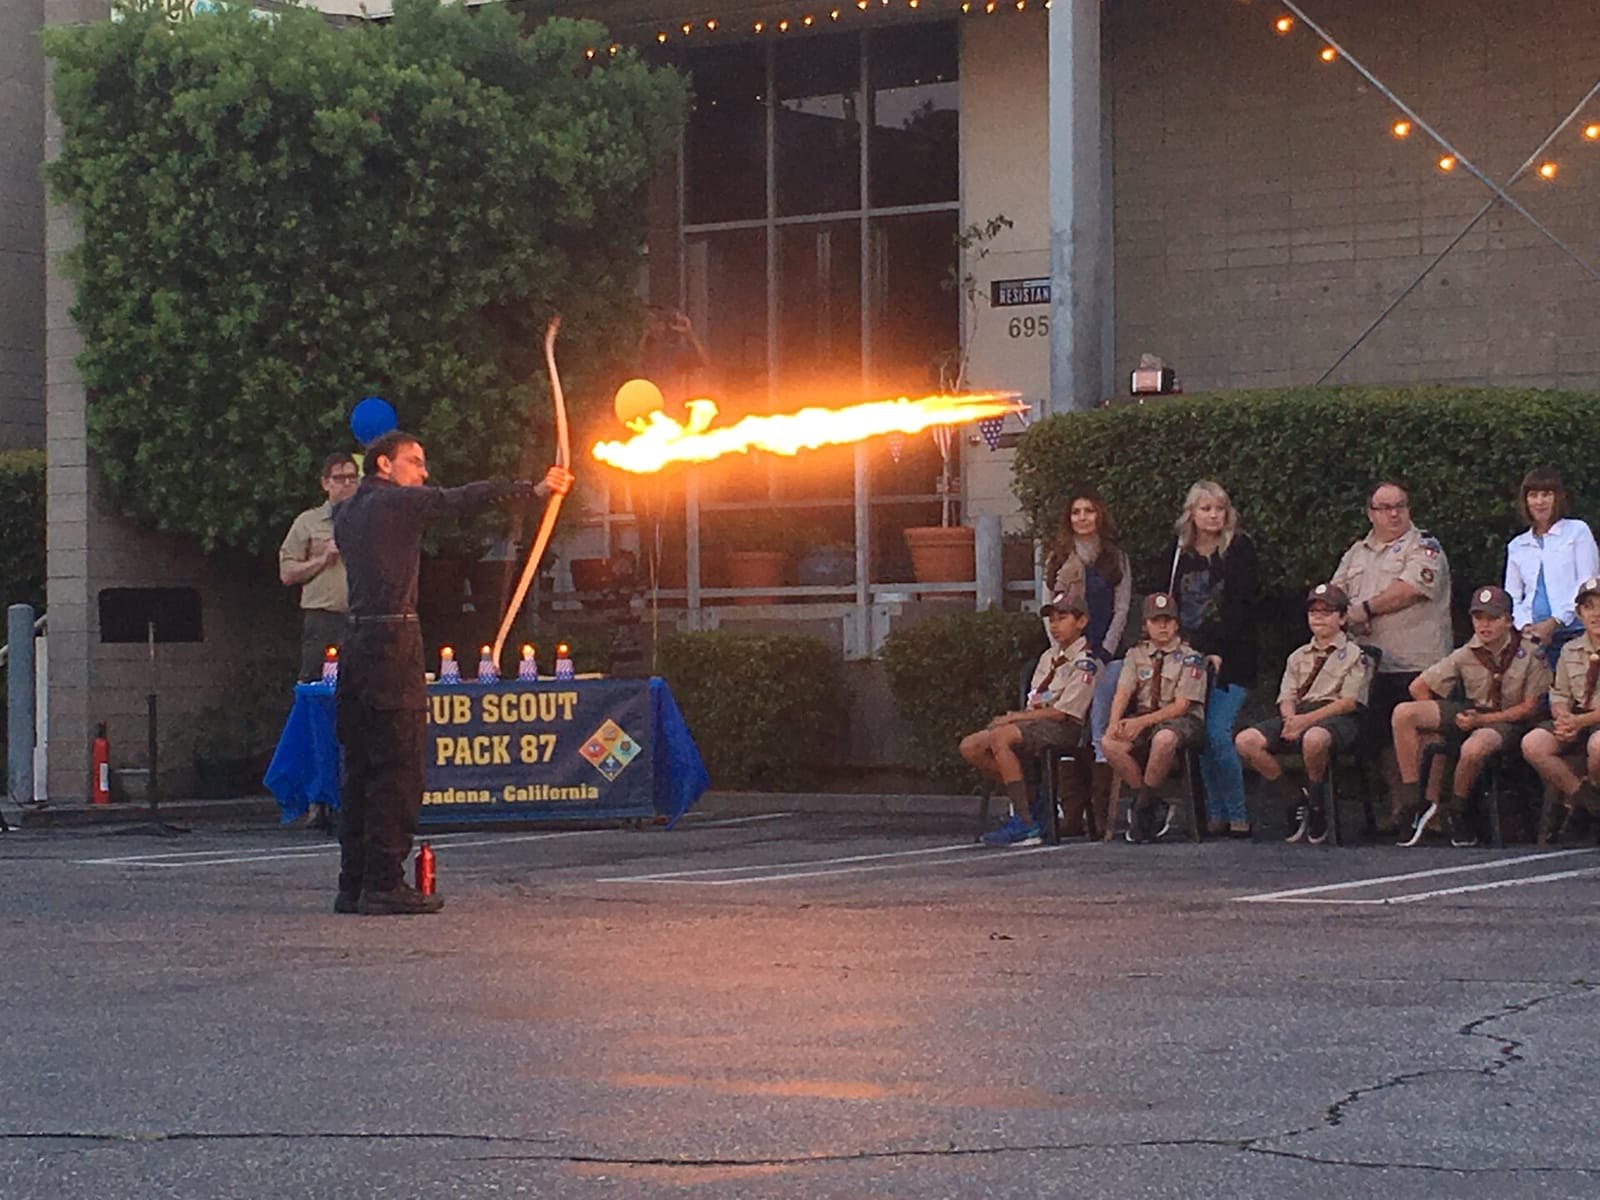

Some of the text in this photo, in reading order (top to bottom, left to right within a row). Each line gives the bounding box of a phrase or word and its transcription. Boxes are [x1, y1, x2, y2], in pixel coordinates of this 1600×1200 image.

[1008, 315, 1049, 338] 695
[481, 692, 578, 723] SCOUT
[435, 734, 557, 766] PACK 87
[503, 783, 599, 802] California
